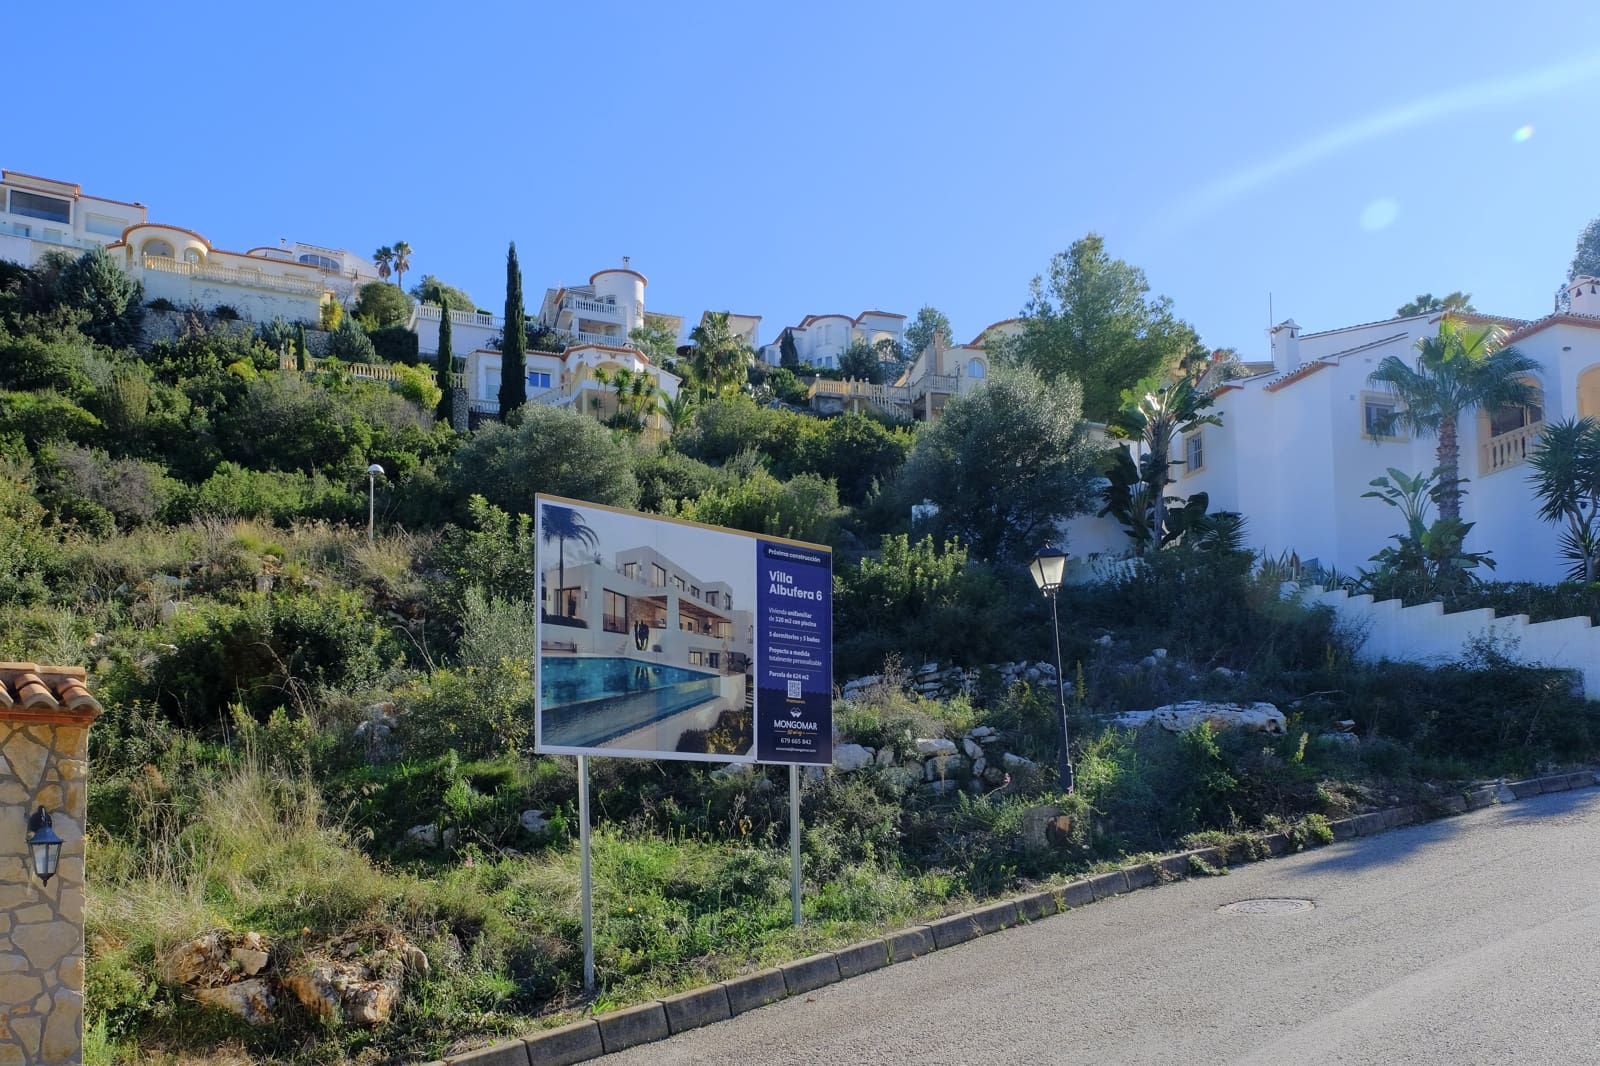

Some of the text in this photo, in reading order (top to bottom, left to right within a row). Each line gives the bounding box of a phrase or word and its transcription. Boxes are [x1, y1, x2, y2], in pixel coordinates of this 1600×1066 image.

[768, 570, 793, 584] Villa
[769, 584, 823, 601] Albufera 6
[768, 607, 812, 619] Vivienda unifamiliar
[773, 631, 799, 640] dormitorios
[806, 635, 820, 643] baños
[768, 646, 789, 654] Proyecto
[768, 655, 792, 663] totalmente
[768, 670, 786, 678] Parcela
[773, 719, 818, 730] MONGOMAR
